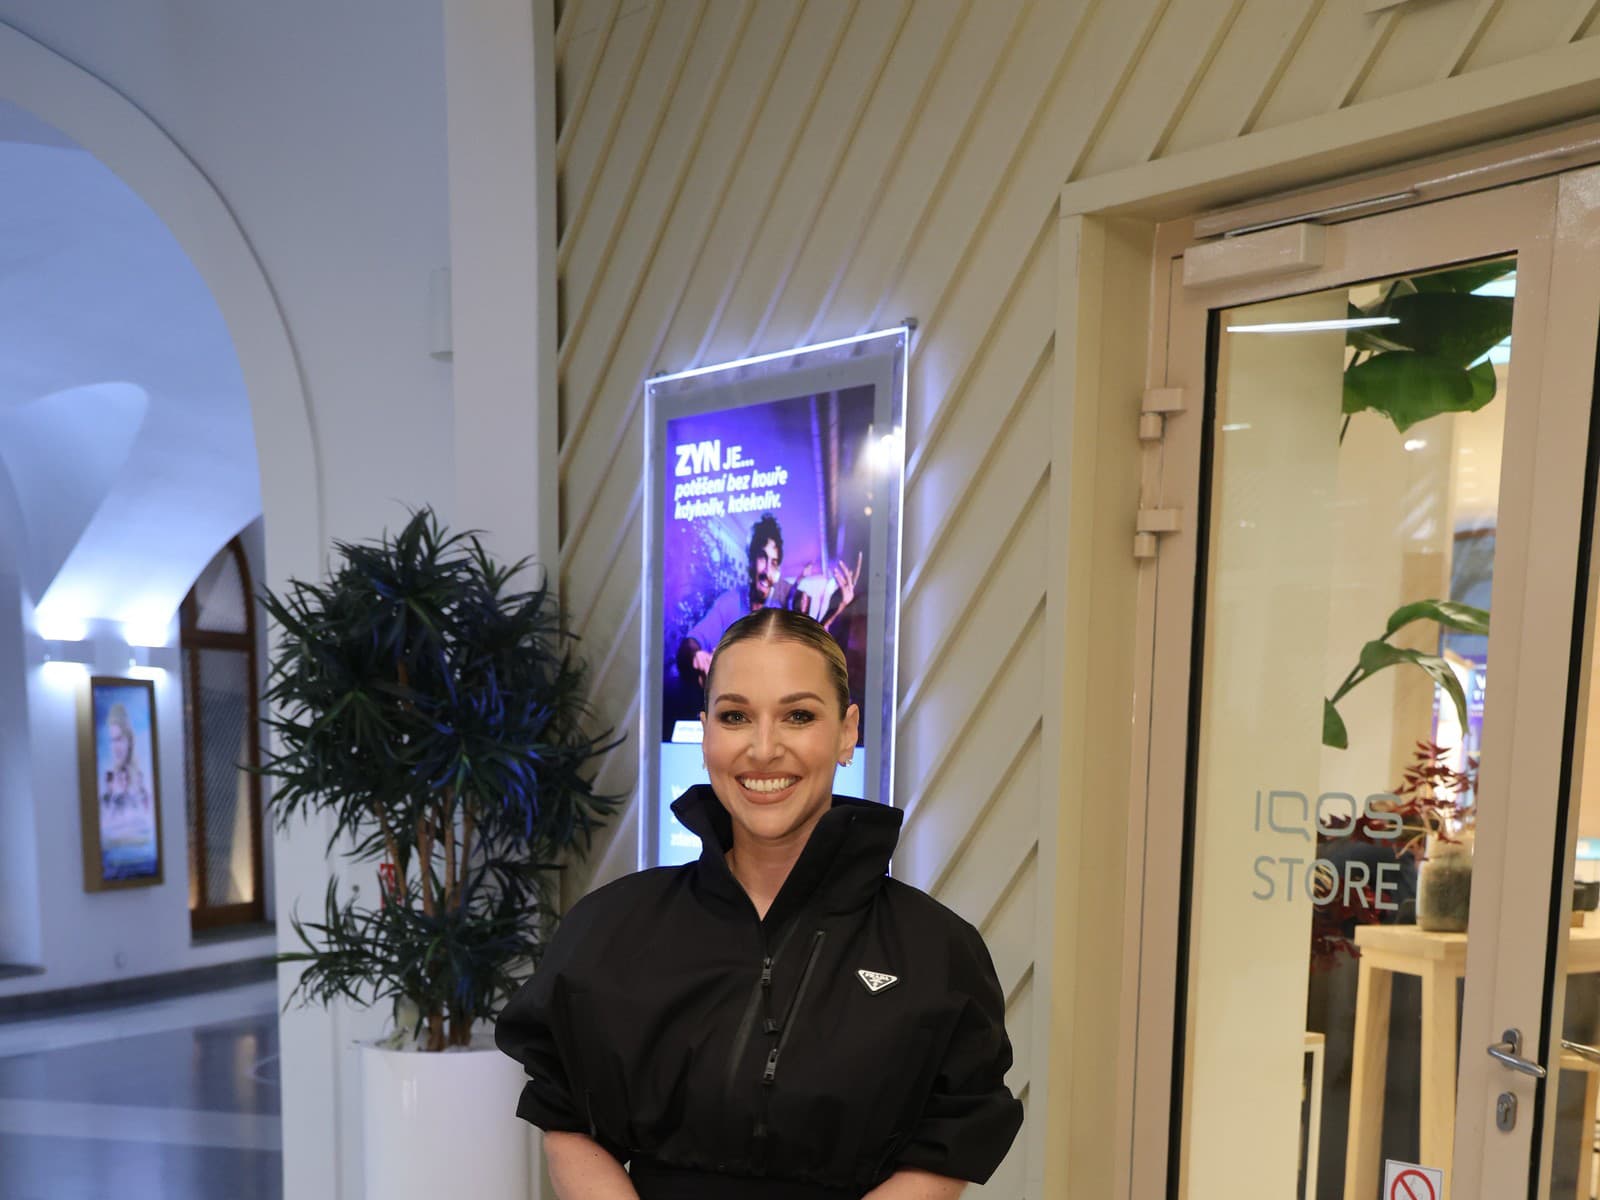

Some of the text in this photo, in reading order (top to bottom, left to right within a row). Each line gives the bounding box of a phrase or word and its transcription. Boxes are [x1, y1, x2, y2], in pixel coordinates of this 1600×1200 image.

[675, 439, 754, 477] ZYN JE...
[674, 465, 788, 502] potěšení bez kouře
[1254, 790, 1404, 843] IQOS
[1252, 855, 1401, 911] STORE
